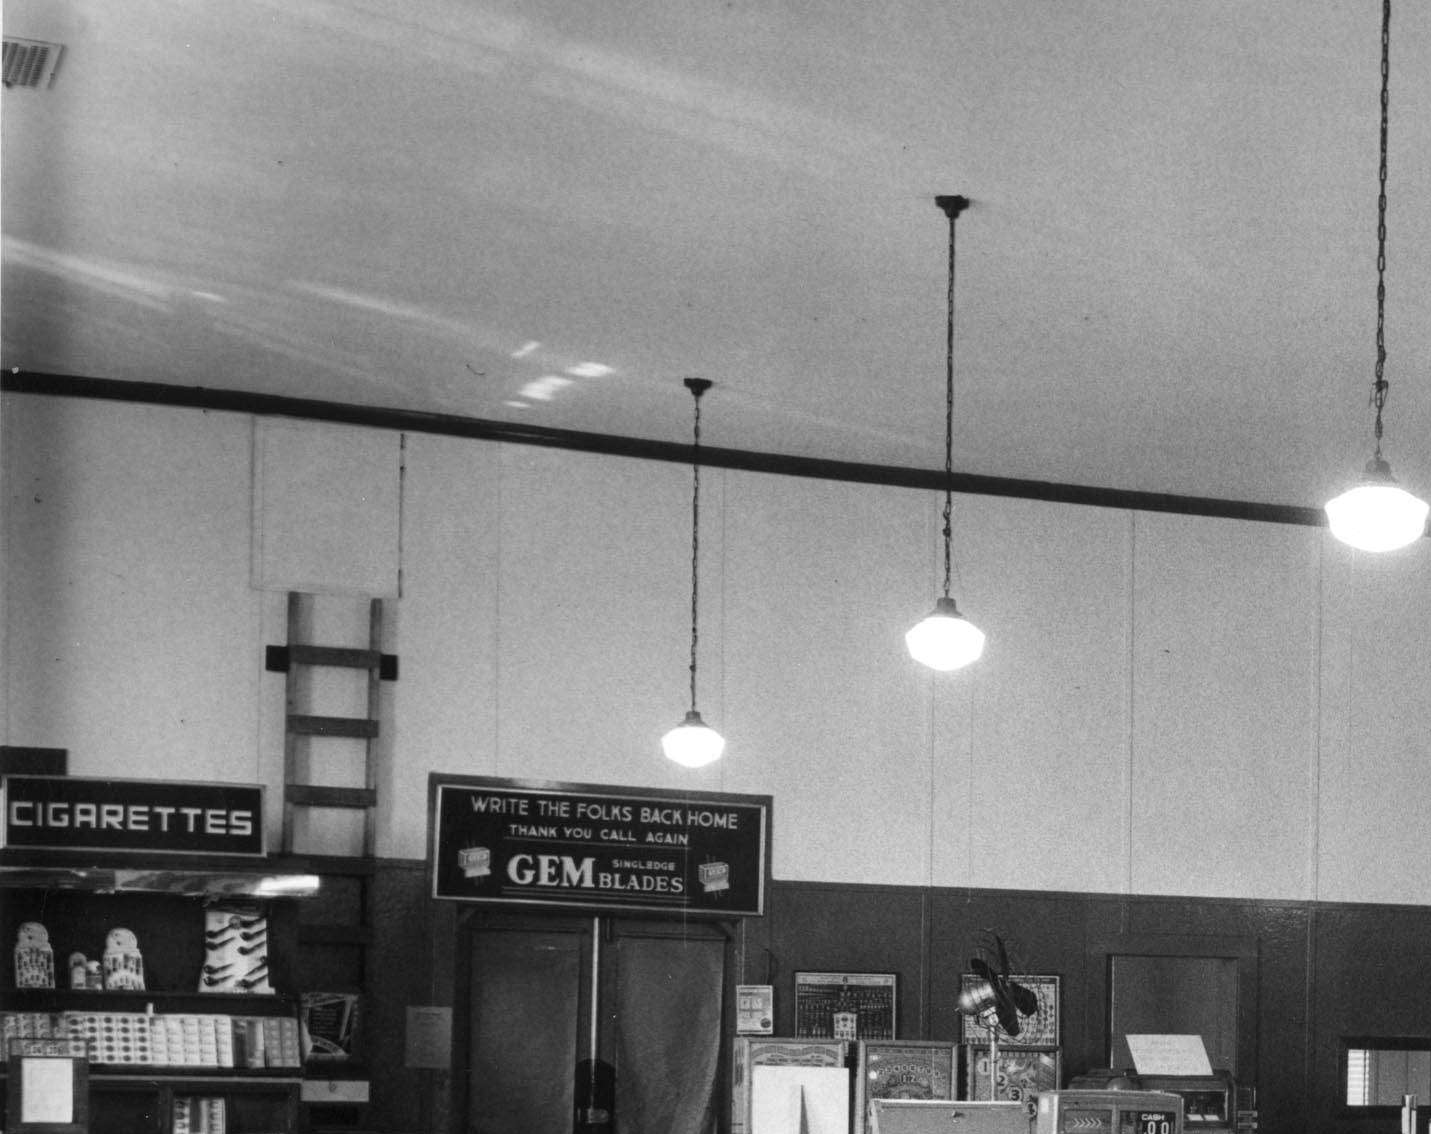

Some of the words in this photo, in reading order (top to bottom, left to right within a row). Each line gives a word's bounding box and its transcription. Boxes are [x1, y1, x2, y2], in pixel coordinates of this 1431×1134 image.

[10, 801, 253, 836] CIGARETTES
[471, 796, 529, 815] WRITE
[537, 800, 570, 817] THE
[577, 803, 633, 822] FOLKS
[640, 807, 683, 825] BACK
[687, 811, 739, 830] HOME
[510, 824, 557, 838] THANK
[564, 827, 592, 839] YOU
[600, 829, 637, 842] CALL
[646, 833, 689, 846] AGAIN
[507, 854, 596, 888] GEM
[612, 859, 676, 871] SINGLEDGE
[598, 872, 684, 893] BLADES
[998, 1075, 1006, 1086] 2
[1011, 1089, 1020, 1101] 3
[1141, 1113, 1165, 1121] CASH
